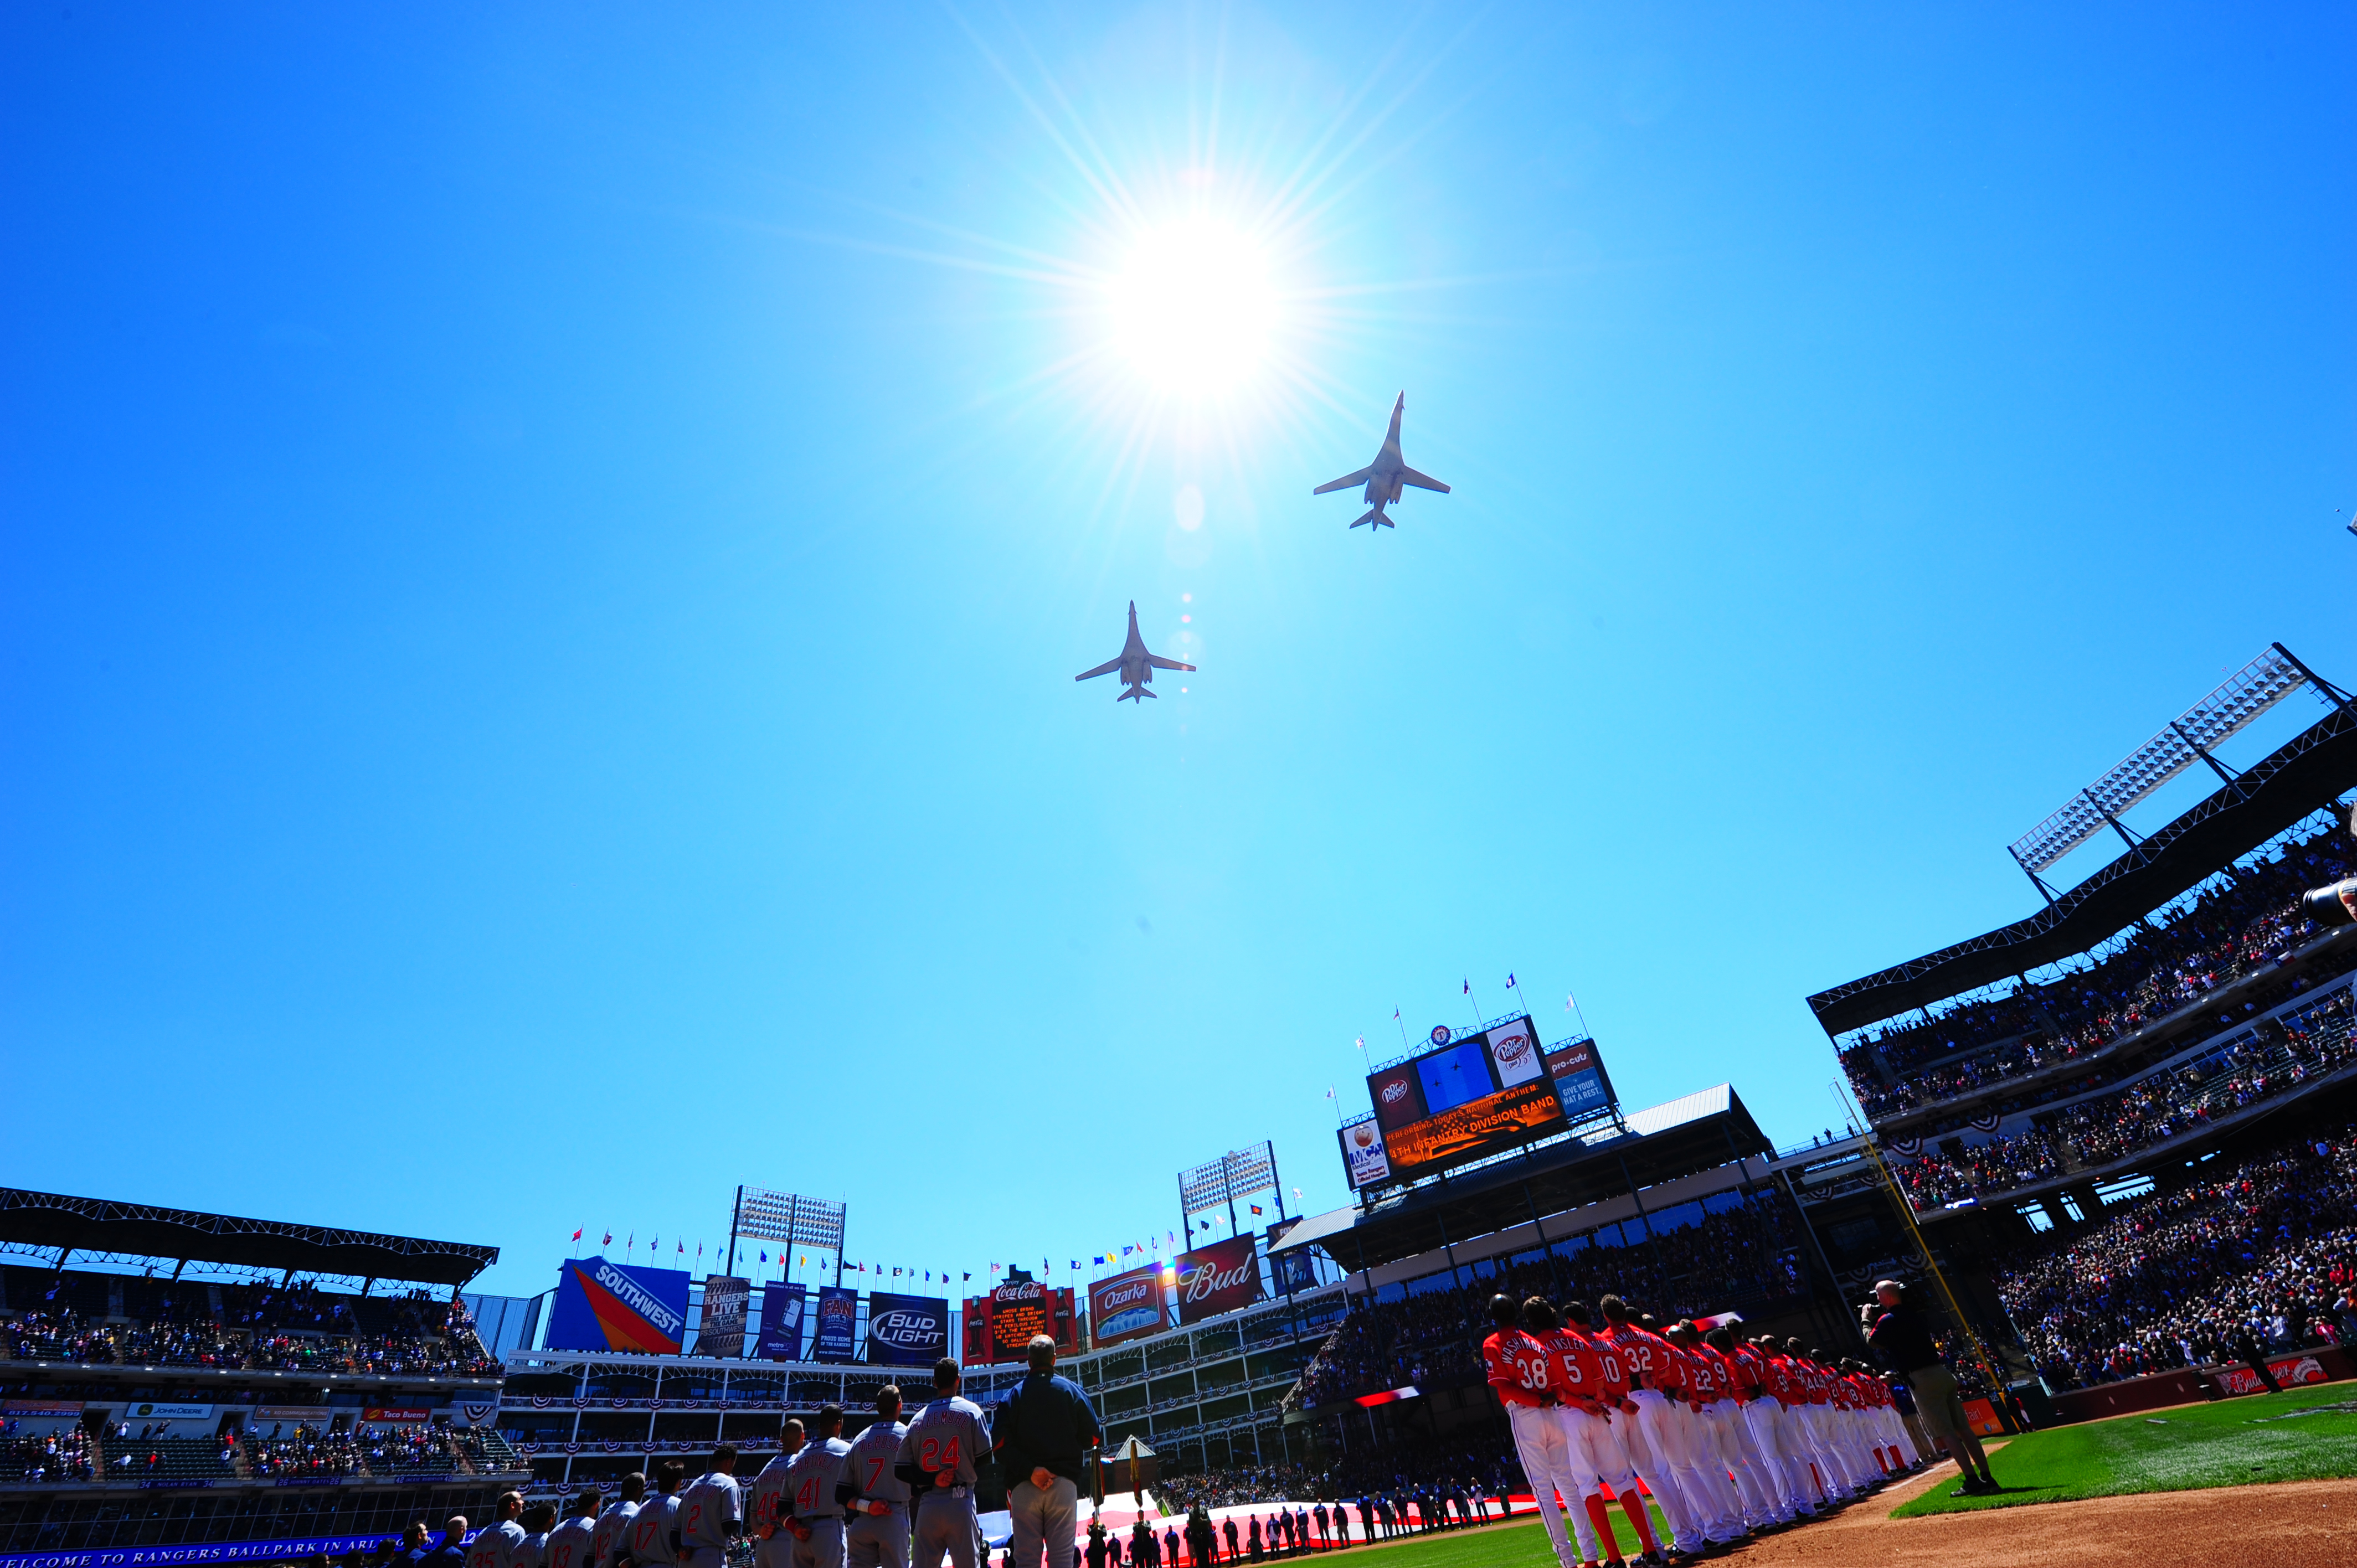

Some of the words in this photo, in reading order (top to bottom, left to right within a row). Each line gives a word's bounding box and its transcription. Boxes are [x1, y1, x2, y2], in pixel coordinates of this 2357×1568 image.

[1500, 1039, 1524, 1060] Pepper
[1506, 1038, 1516, 1048] Dr
[1385, 1084, 1404, 1103] Pepper
[1389, 1083, 1398, 1092] Dr
[1563, 1085, 1578, 1096] GIVE
[1577, 1080, 1595, 1091] YOUR
[1563, 1095, 1577, 1106] HAT
[1582, 1087, 1602, 1099] REST.
[1386, 1122, 1432, 1142] PERFORMING
[1433, 1110, 1465, 1126] TODAY'S
[1466, 1097, 1504, 1115] NATIONAL
[1505, 1084, 1540, 1101] ANTHEM:
[1391, 1144, 1411, 1159] 4TH
[1413, 1126, 1466, 1152] INFANTRY
[1469, 1108, 1519, 1132] DIVISION
[1521, 1095, 1555, 1115] BAND
[1178, 1252, 1253, 1303] Bud
[595, 1265, 681, 1334] SOUTHWEST
[704, 1292, 749, 1305] RANGERS
[823, 1298, 853, 1318] FAN
[1104, 1283, 1147, 1309] Ozarka
[711, 1302, 740, 1316] LIVE
[827, 1314, 847, 1324] 105.3
[887, 1313, 936, 1329] BUD
[877, 1327, 944, 1344] LIGHT
[1543, 1338, 1585, 1355] KINSLER
[1610, 1330, 1651, 1347] HAMILTON
[1501, 1337, 1550, 1367] WASHINGTON
[1624, 1346, 1653, 1373] 32
[1517, 1358, 1548, 1389] 38
[1563, 1355, 1582, 1384] 5
[1599, 1356, 1620, 1383] 10
[1692, 1369, 1715, 1391] 22
[914, 1410, 971, 1434] SIZEMORE
[791, 1454, 838, 1477] MARTINEZ
[921, 1435, 960, 1473] 24
[863, 1457, 885, 1492] 7
[796, 1475, 821, 1510] 41
[757, 1491, 780, 1522] 48
[687, 1504, 701, 1534] 2
[596, 1533, 611, 1560] 12
[635, 1521, 658, 1550] 17
[100, 1554, 124, 1565] TO
[132, 1549, 221, 1564] RANGERS
[227, 1542, 318, 1558] BALLPARK
[323, 1541, 342, 1551] IN
[473, 1551, 496, 1568] 35
[553, 1545, 572, 1568] 13
